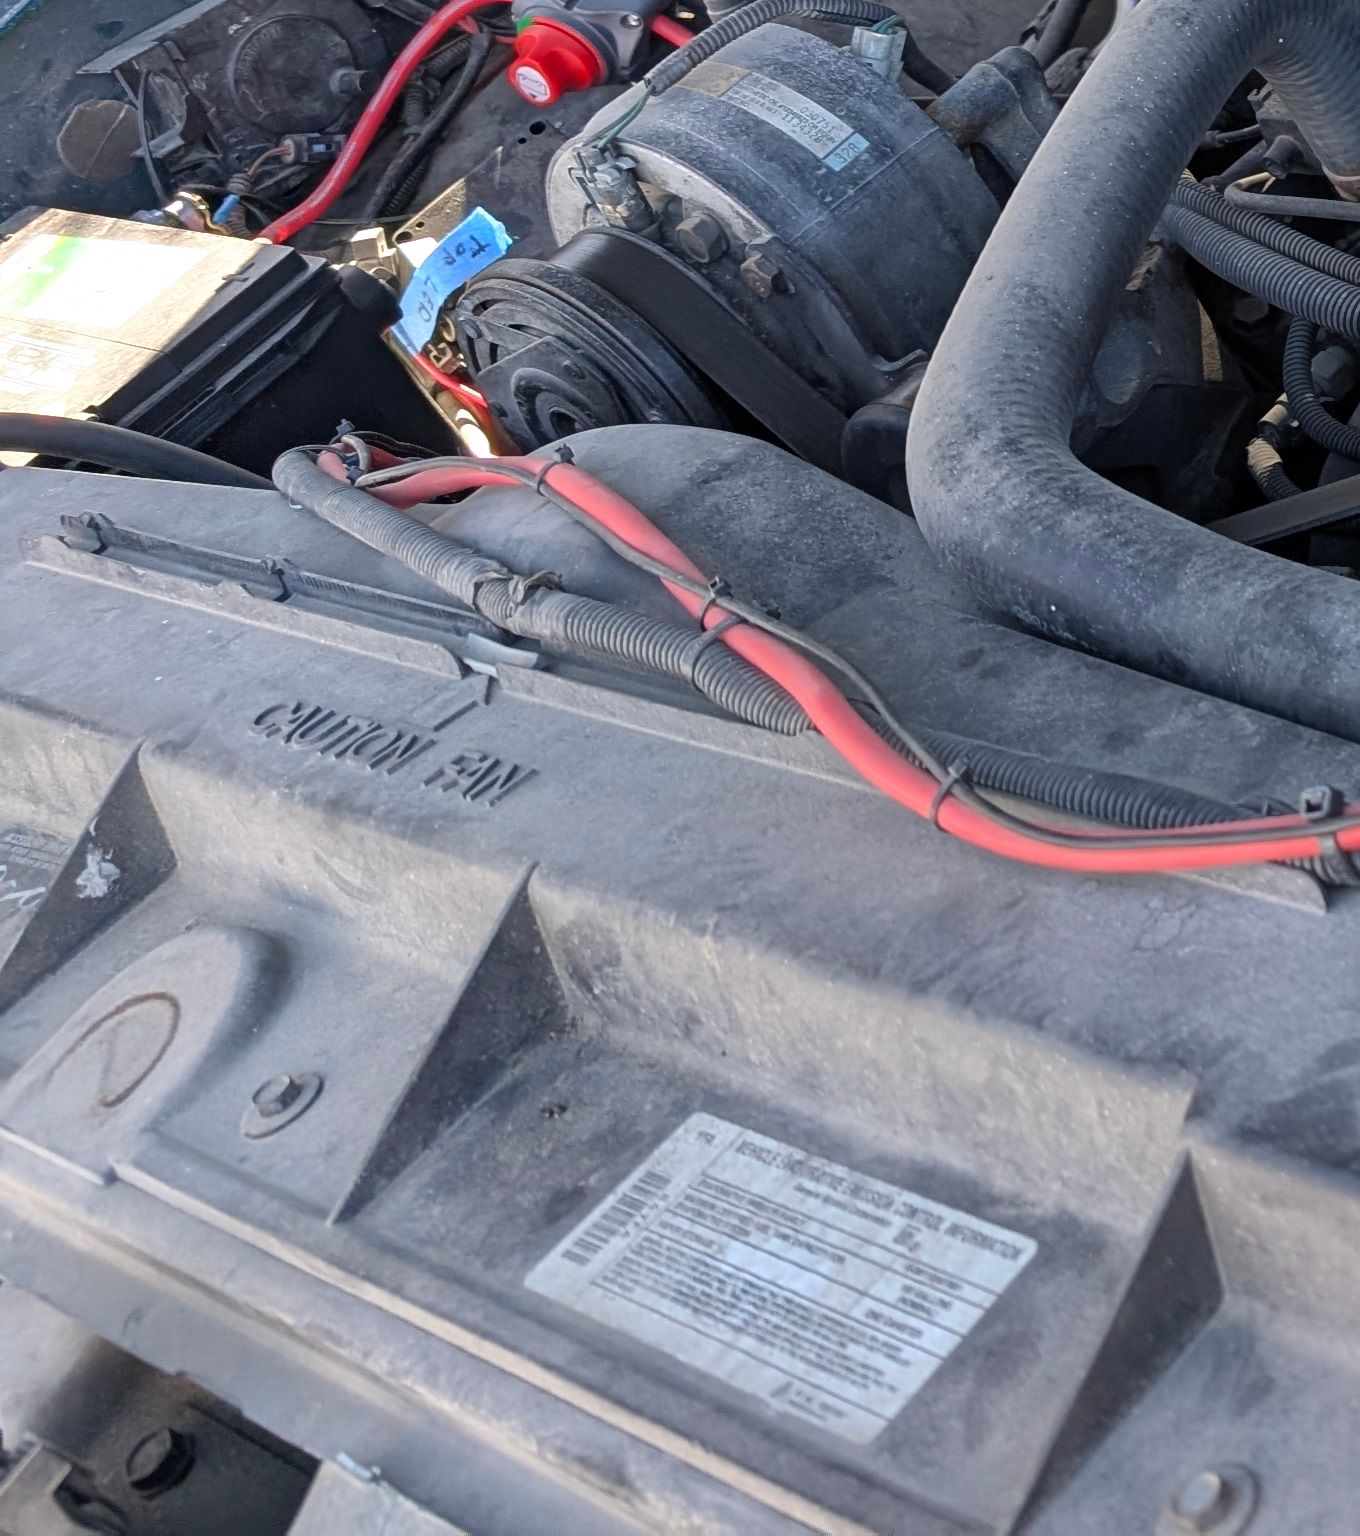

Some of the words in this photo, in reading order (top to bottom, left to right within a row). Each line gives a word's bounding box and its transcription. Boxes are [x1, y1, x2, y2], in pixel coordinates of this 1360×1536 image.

[834, 142, 862, 164] 328
[253, 702, 436, 776] CAUTION
[422, 751, 540, 808] FAN
